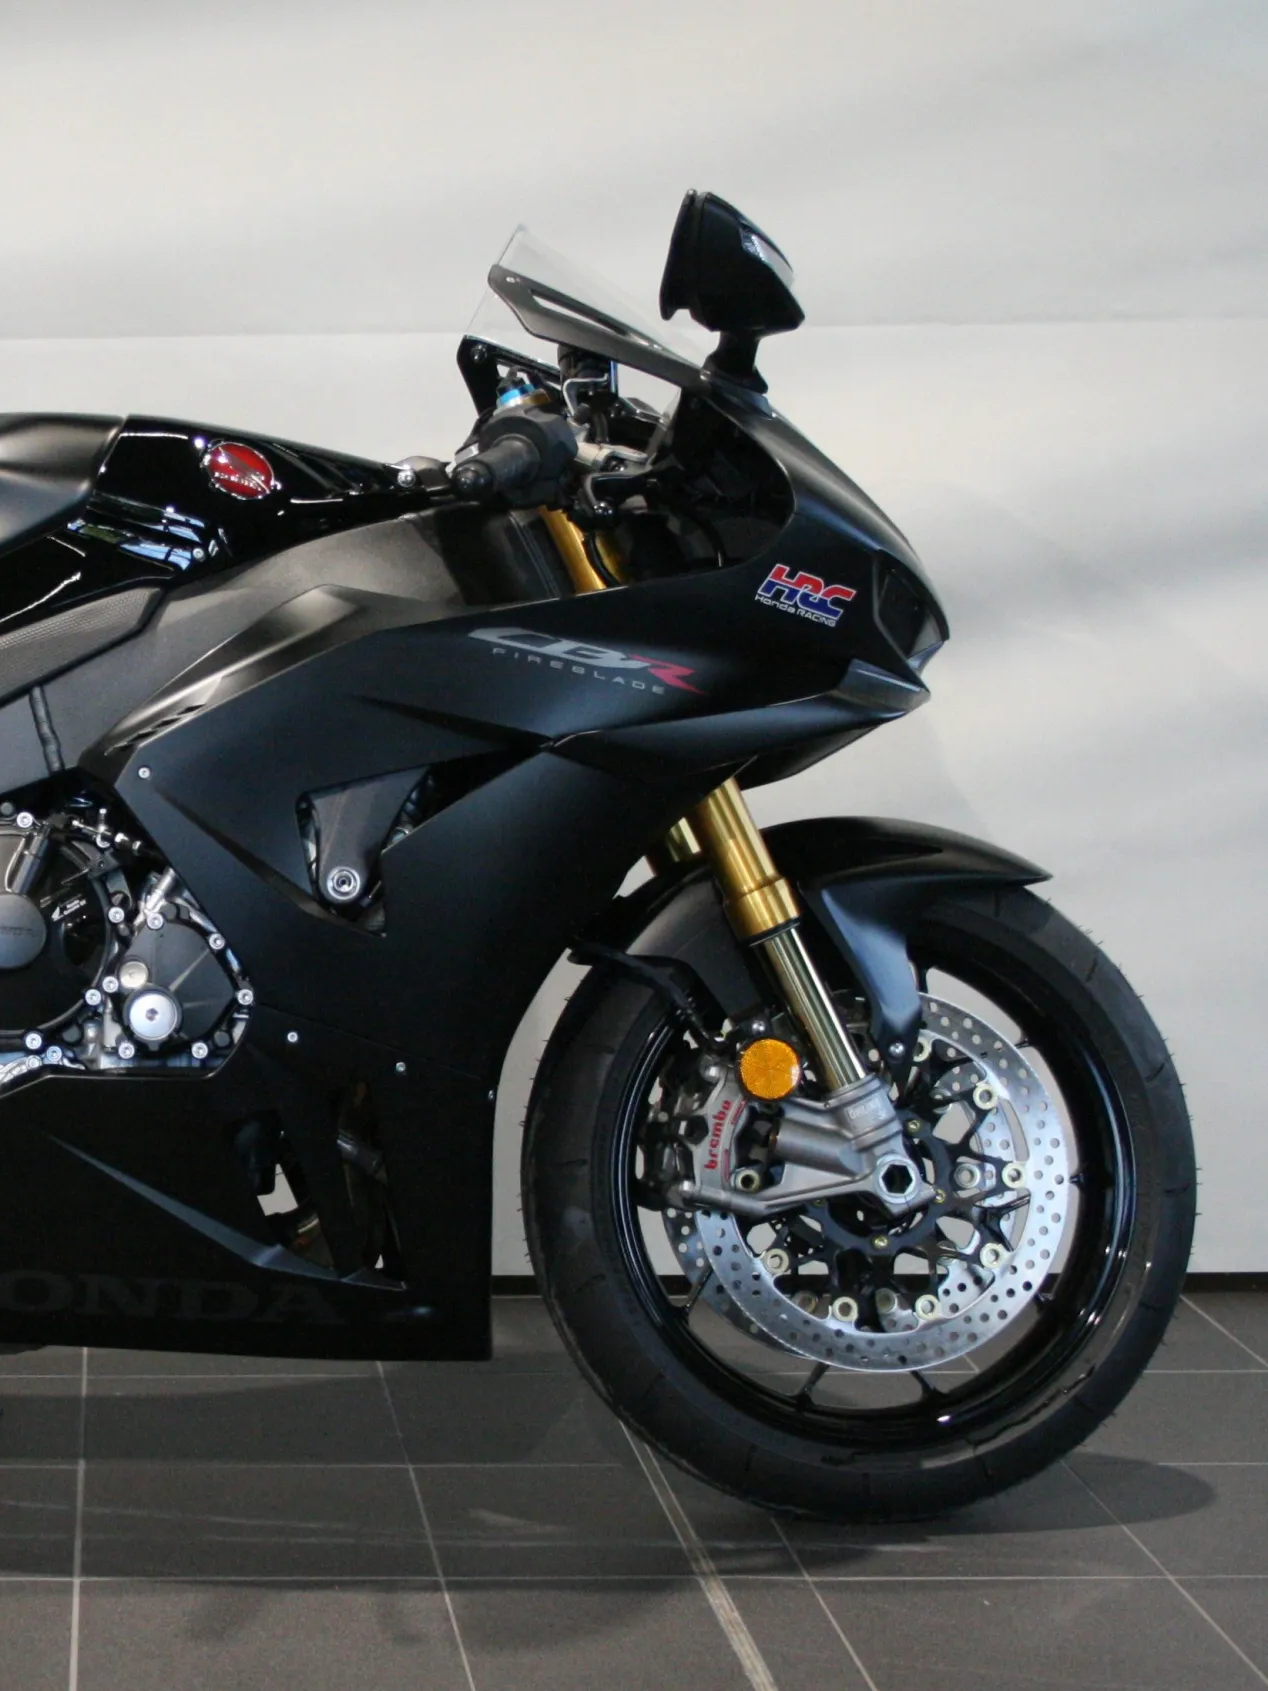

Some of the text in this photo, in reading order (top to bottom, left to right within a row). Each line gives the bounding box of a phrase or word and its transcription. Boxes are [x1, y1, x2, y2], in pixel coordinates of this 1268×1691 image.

[754, 594, 837, 628] Honda RACING
[757, 563, 857, 620] HRC
[468, 627, 708, 696] CBR
[492, 647, 666, 695] FIREBLADE
[703, 1099, 732, 1170] brembo
